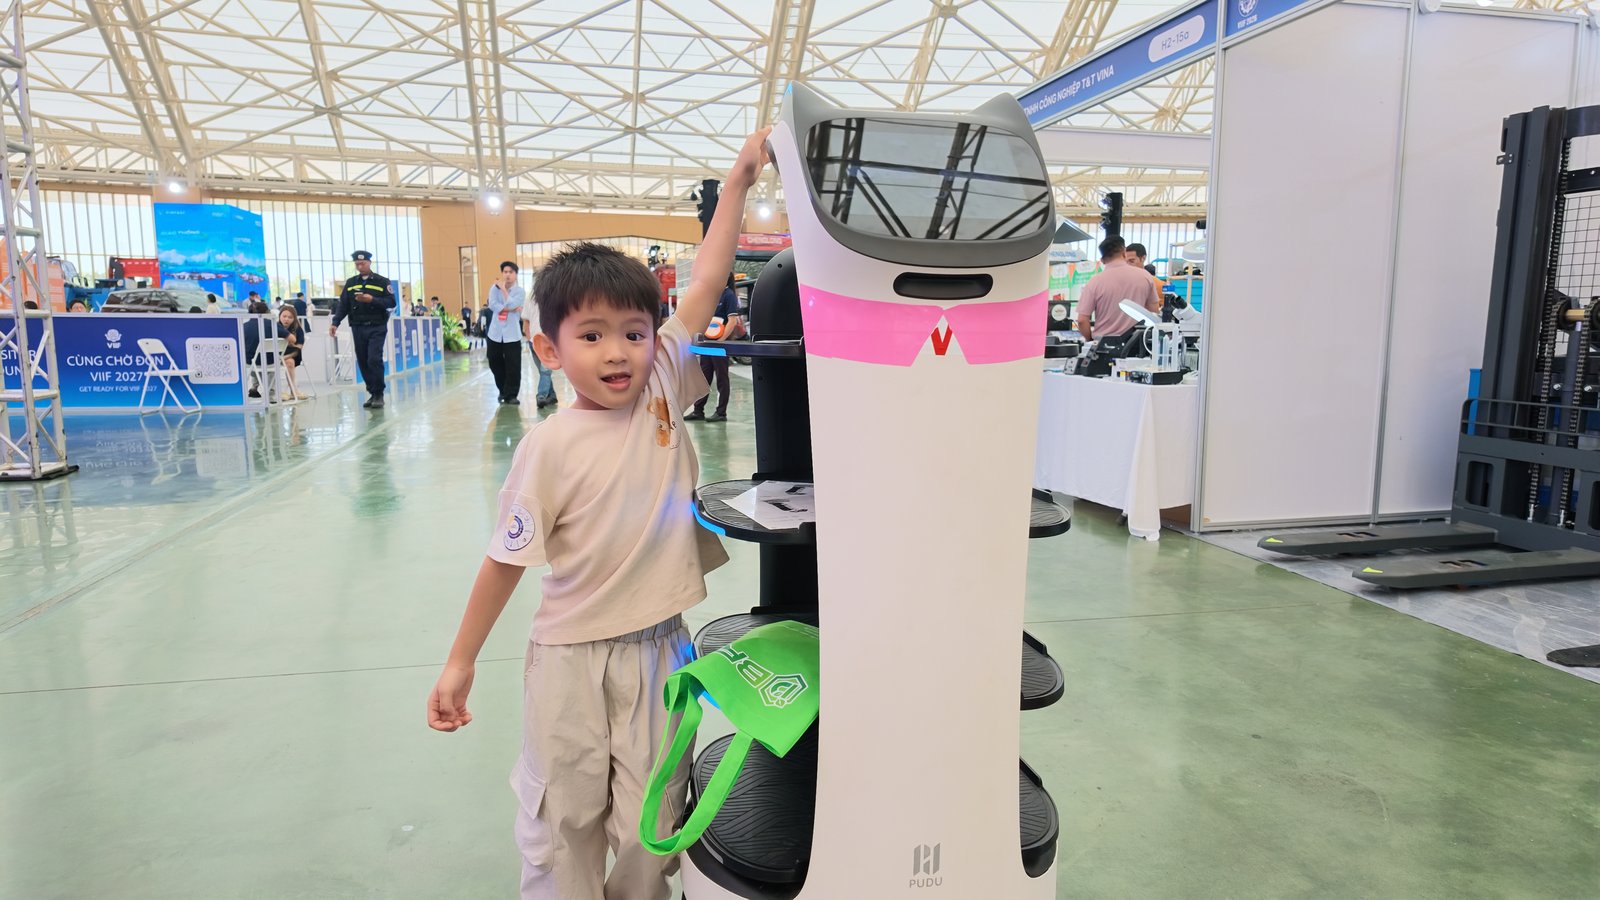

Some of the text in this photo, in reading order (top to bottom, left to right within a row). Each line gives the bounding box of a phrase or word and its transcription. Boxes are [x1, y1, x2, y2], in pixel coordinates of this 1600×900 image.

[1039, 93, 1057, 109] CÔNG
[1057, 81, 1081, 102] NGHIỆP
[1081, 73, 1096, 90] T&T
[1096, 65, 1114, 82] VINA
[66, 354, 103, 367] CÙNG
[105, 354, 133, 367] CHỜ
[89, 371, 143, 382] VIIF 2027
[79, 385, 92, 393] GET
[93, 385, 114, 393] READY
[909, 876, 943, 889] PUDU
